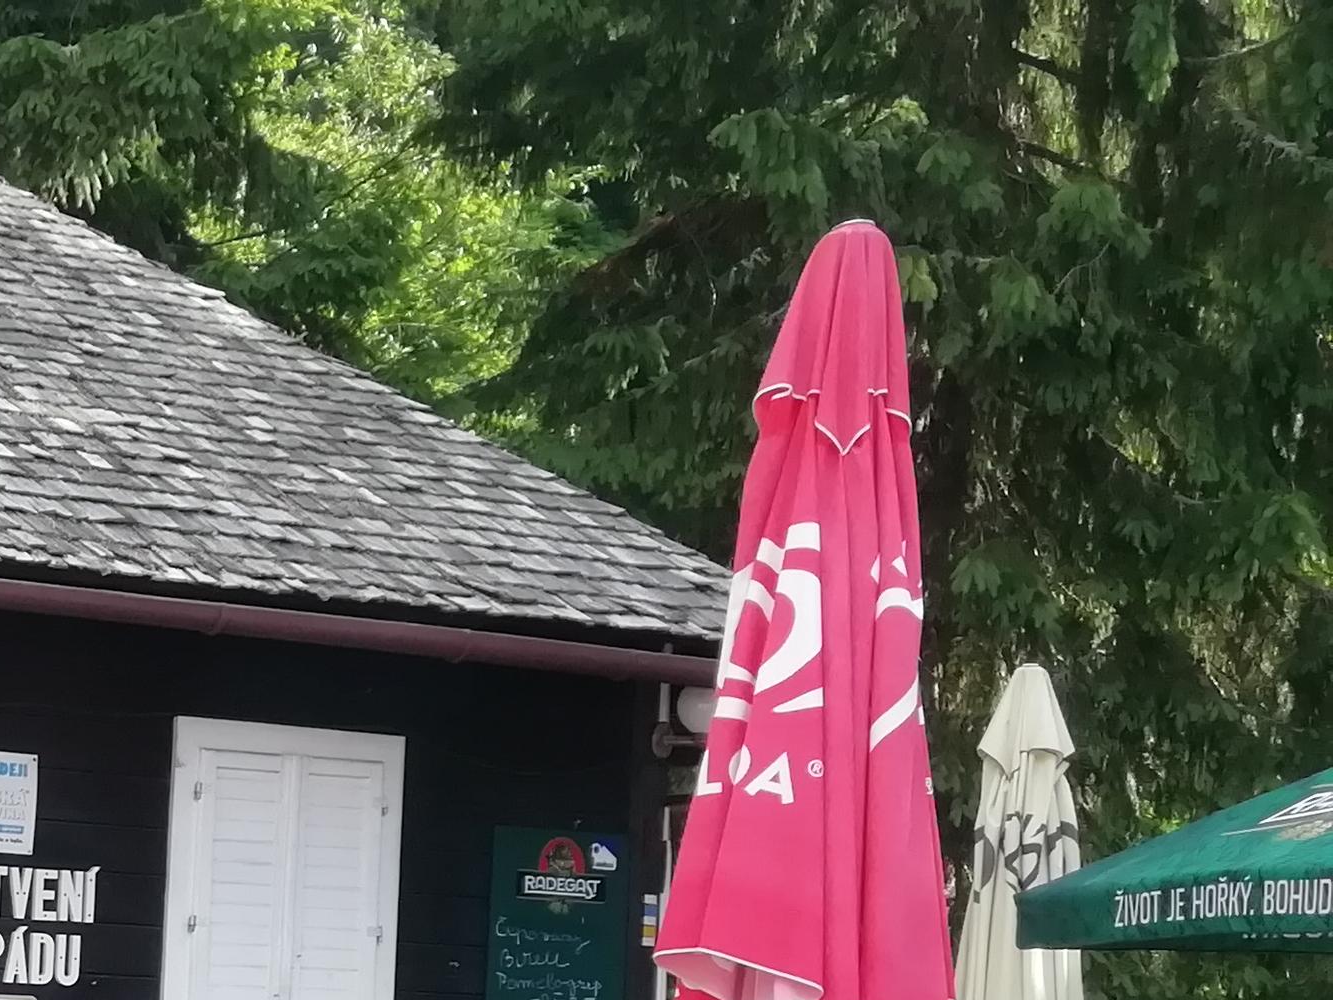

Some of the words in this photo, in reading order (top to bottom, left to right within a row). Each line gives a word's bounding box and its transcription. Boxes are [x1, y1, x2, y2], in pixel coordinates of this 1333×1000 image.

[524, 875, 601, 899] RADEGAST
[1114, 888, 1161, 928] ŽIVOT
[1166, 888, 1185, 922] JE
[1192, 875, 1255, 919] HOŘKÝ.
